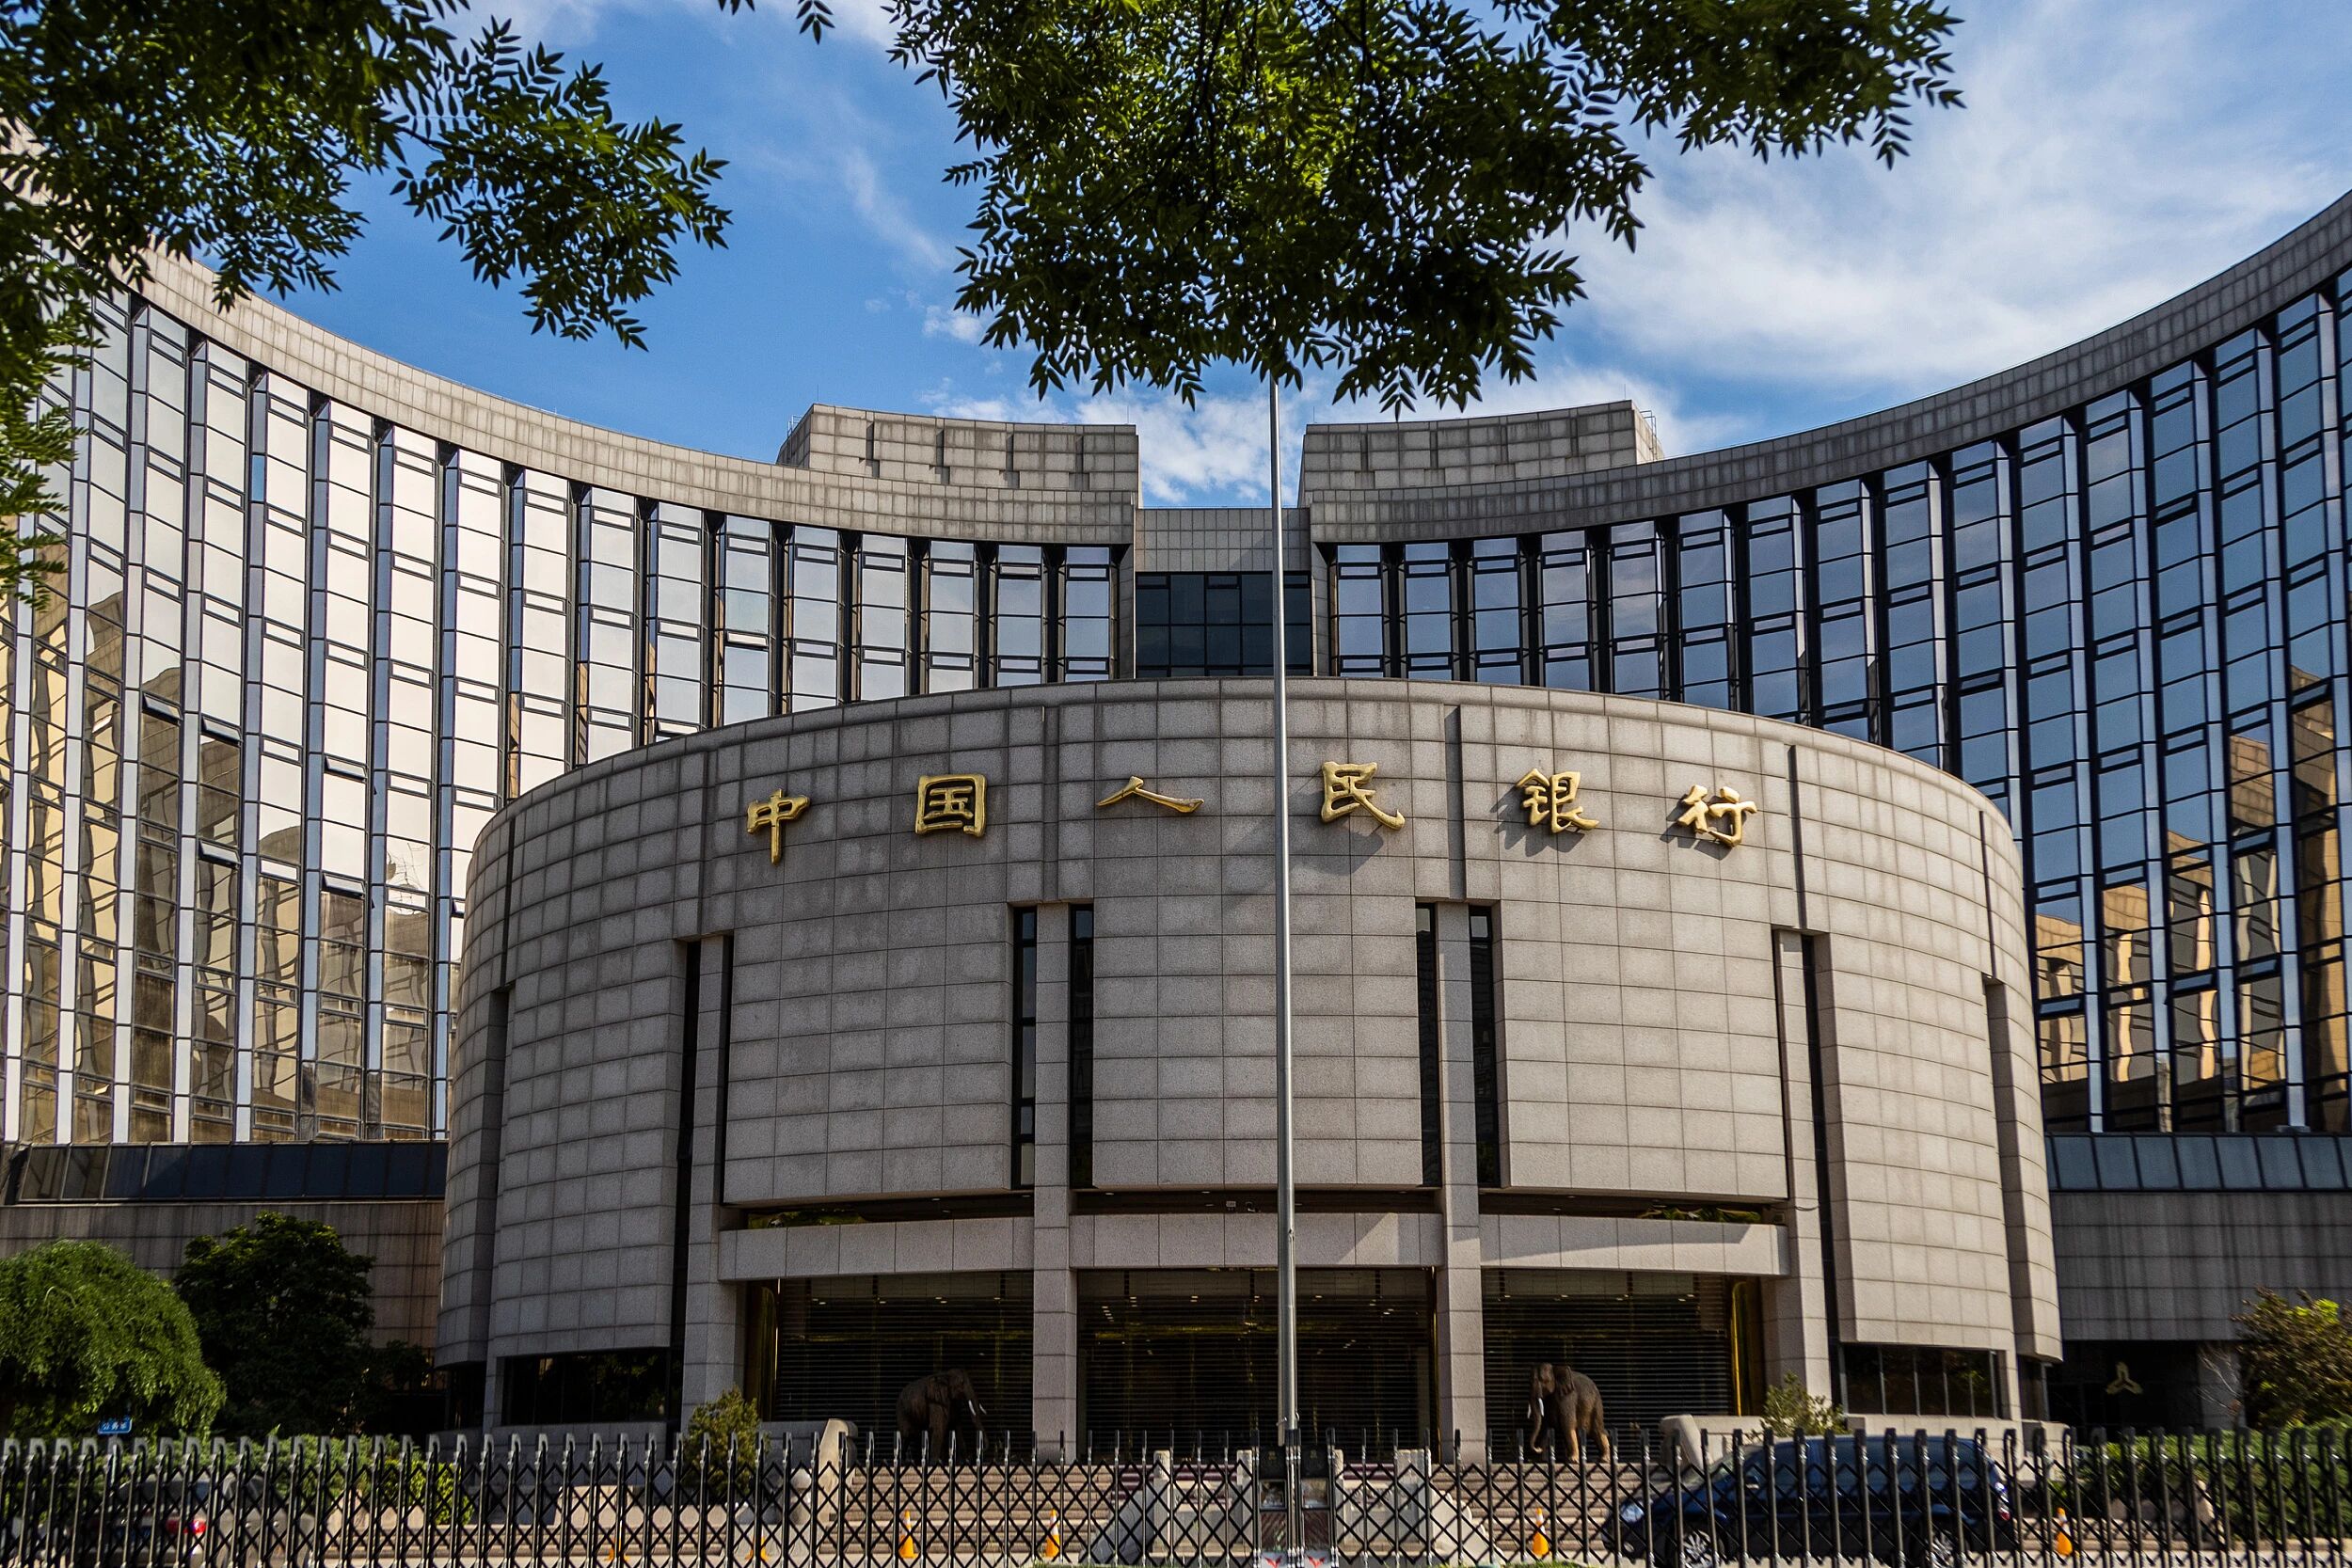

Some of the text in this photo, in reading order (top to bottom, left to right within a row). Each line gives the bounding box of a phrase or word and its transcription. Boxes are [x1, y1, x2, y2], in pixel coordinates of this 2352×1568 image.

[746, 760, 1757, 863] 中国人民银行
